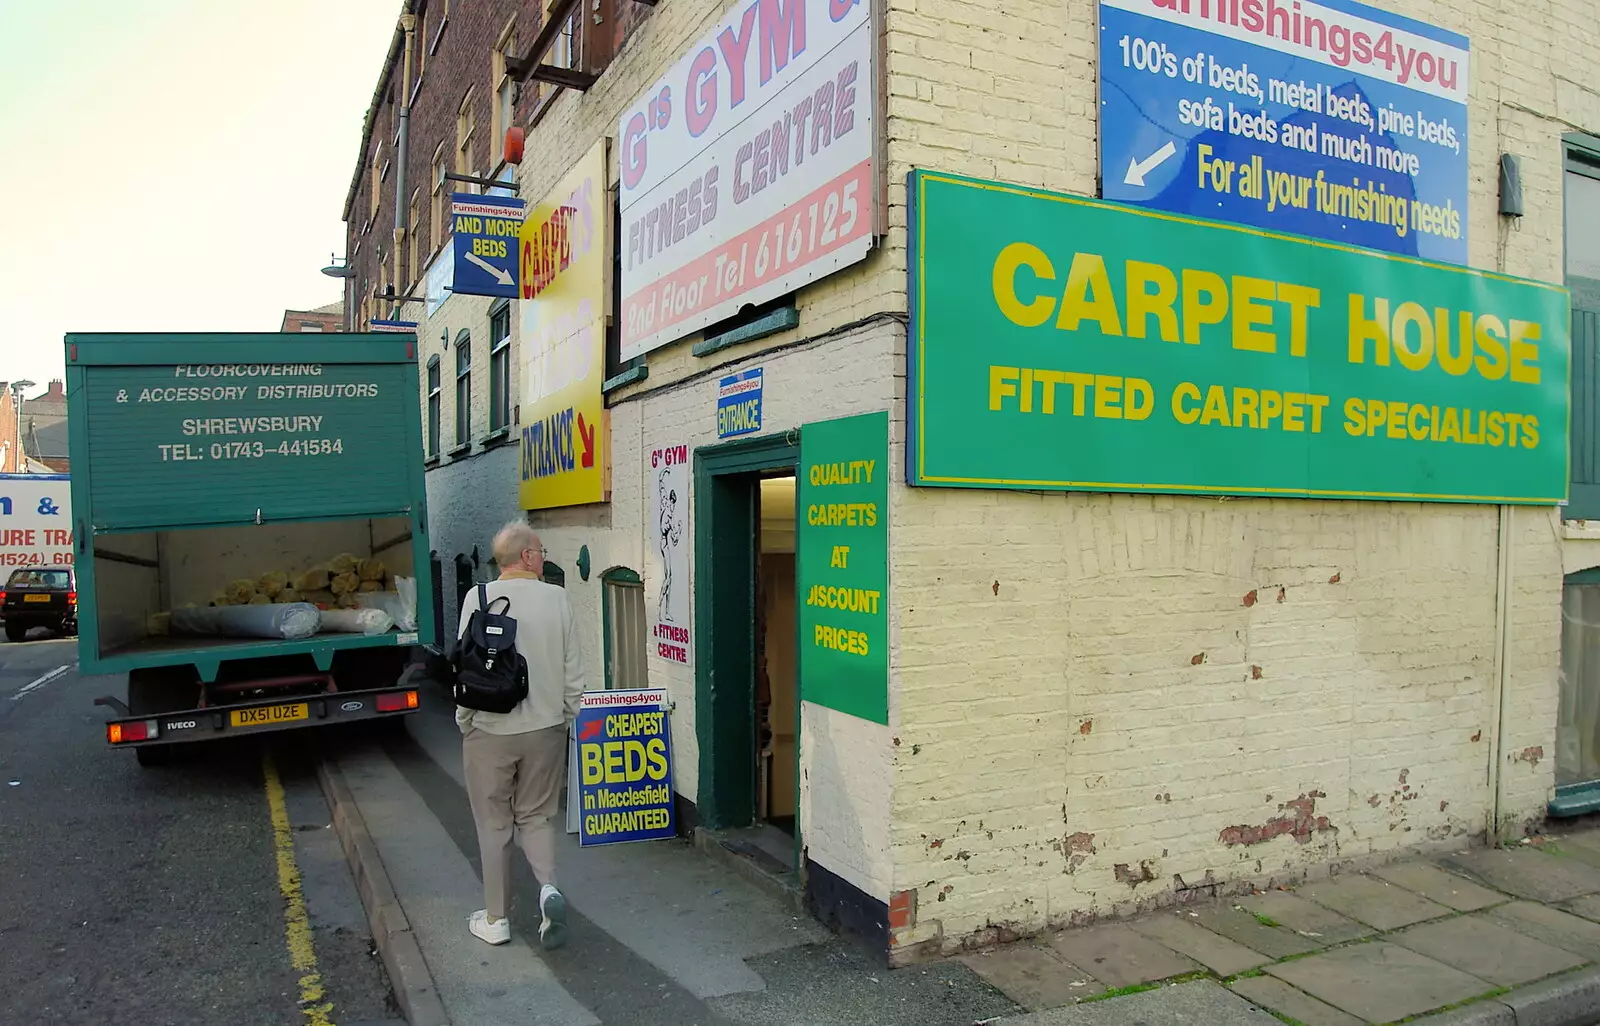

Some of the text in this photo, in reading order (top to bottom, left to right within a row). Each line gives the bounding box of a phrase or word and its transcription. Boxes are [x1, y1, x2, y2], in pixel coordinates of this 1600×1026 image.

[1153, 0, 1457, 91] nishings4you
[685, 0, 806, 138] GYM
[1119, 34, 1460, 155] 100's of beds, metal beds, pine beds,
[1178, 97, 1420, 177] sofa beds and much more
[627, 60, 857, 272] FITNESS CENTRE
[1198, 144, 1460, 239] For all your furnishing needs
[453, 203, 523, 217] Furnishings4you
[455, 215, 521, 238] AND MORE
[523, 176, 593, 300] CARPETS
[473, 238, 507, 258] BEDS
[628, 179, 859, 339] 2nd Floor Tel 616125
[992, 242, 1541, 385] CARPET HOUSE
[175, 364, 323, 377] FLOORCOVERING
[116, 383, 378, 403] & ACCESSORY DISTRIBUTORS
[718, 399, 759, 435] ENTRANCE
[989, 365, 1540, 449] FITTED CARPET SPECIALISTS
[182, 416, 323, 435] SHREWSBURY
[158, 438, 343, 461] TEL: 01743-441584
[522, 406, 575, 481] ENTRANCE
[664, 444, 687, 466] GYM
[810, 460, 875, 486] QUALITY
[38, 497, 59, 515] &
[808, 503, 877, 526] CARPETS
[830, 546, 850, 569] AT
[659, 623, 688, 644] FITNESS
[815, 624, 868, 656] PRICES
[658, 642, 687, 663] CENTRE
[167, 720, 196, 731] IVECO
[240, 705, 300, 723] DX51 UZE
[605, 711, 664, 738] CHEAPEST
[581, 738, 668, 786] BEDS
[584, 783, 670, 810] in Macclesfield
[585, 808, 670, 836] GUARANTEED
